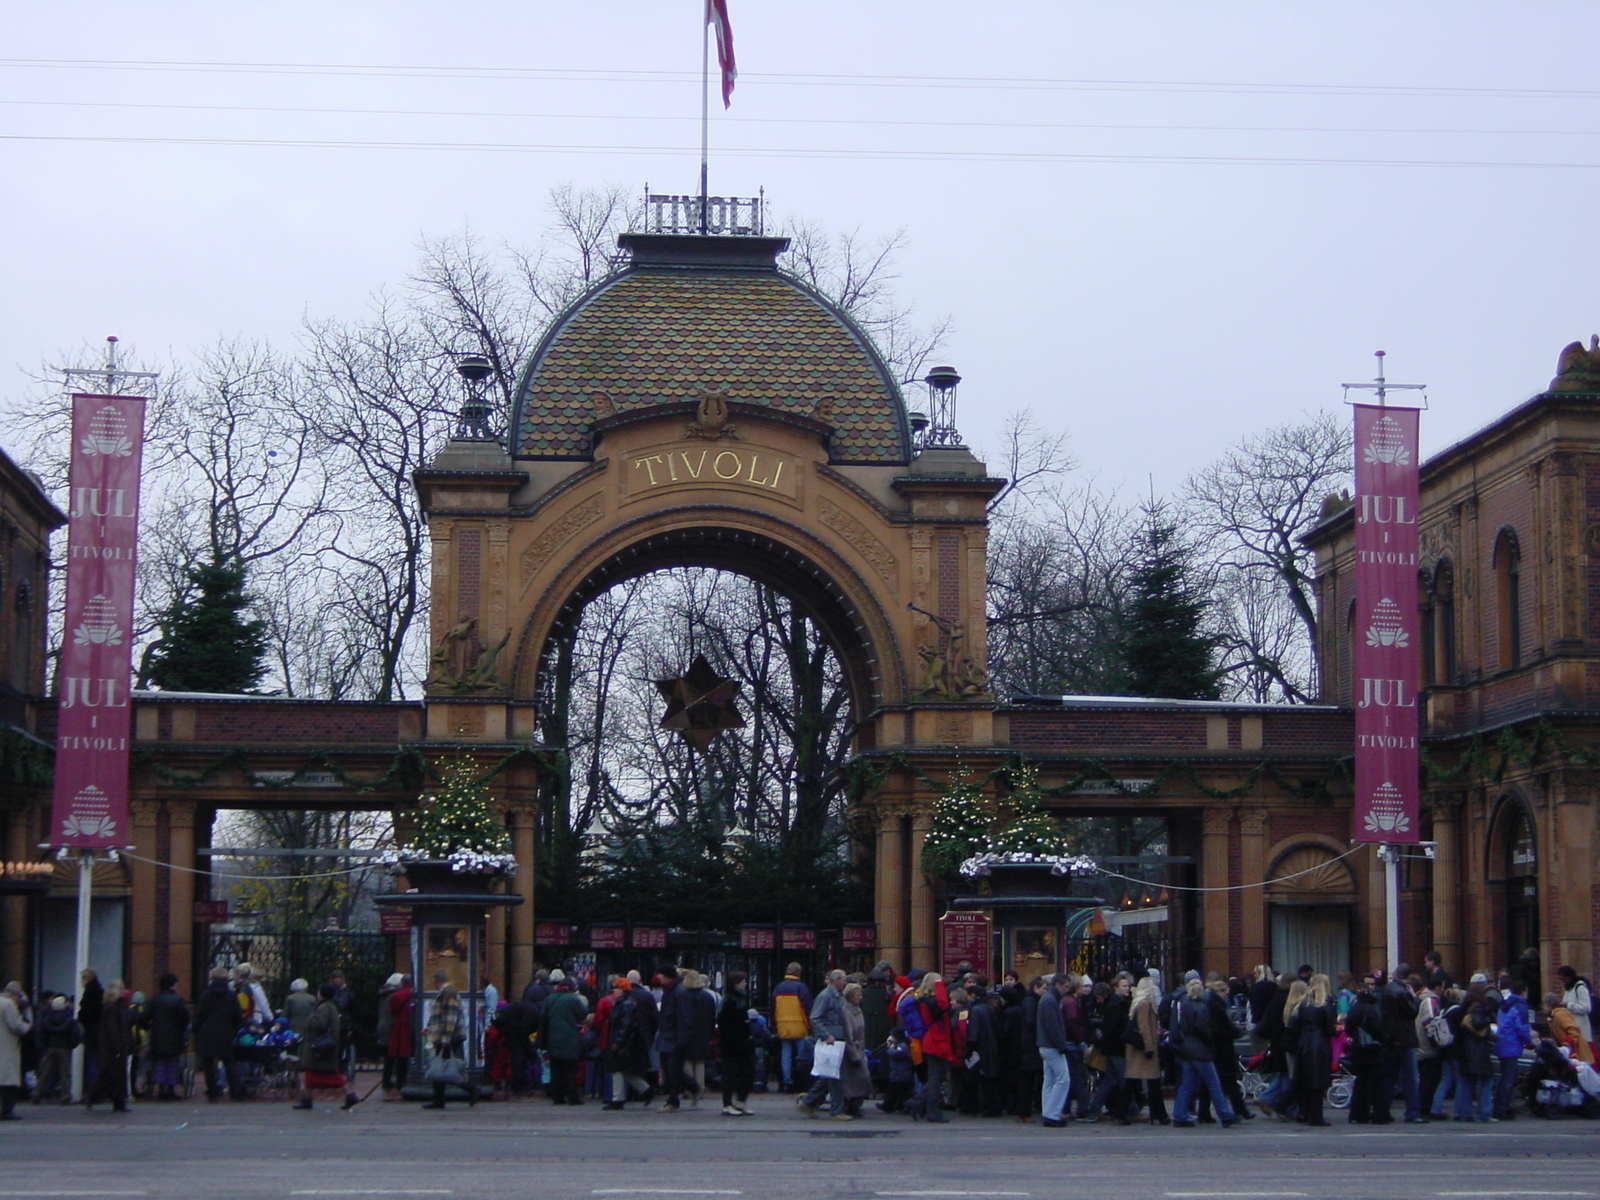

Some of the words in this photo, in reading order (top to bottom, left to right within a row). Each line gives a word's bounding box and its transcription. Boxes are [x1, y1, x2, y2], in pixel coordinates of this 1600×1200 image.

[650, 195, 759, 235] TIVOLI
[635, 450, 784, 488] TIVOLI
[70, 487, 136, 518] JUL
[1357, 494, 1415, 524] JUL
[70, 545, 133, 560] TIVOLI
[1358, 550, 1415, 565] TIVOLI
[61, 677, 127, 709] JUL
[1358, 677, 1415, 708] JUL
[60, 736, 126, 751] TIVOLI
[1358, 734, 1416, 749] TIVOLI
